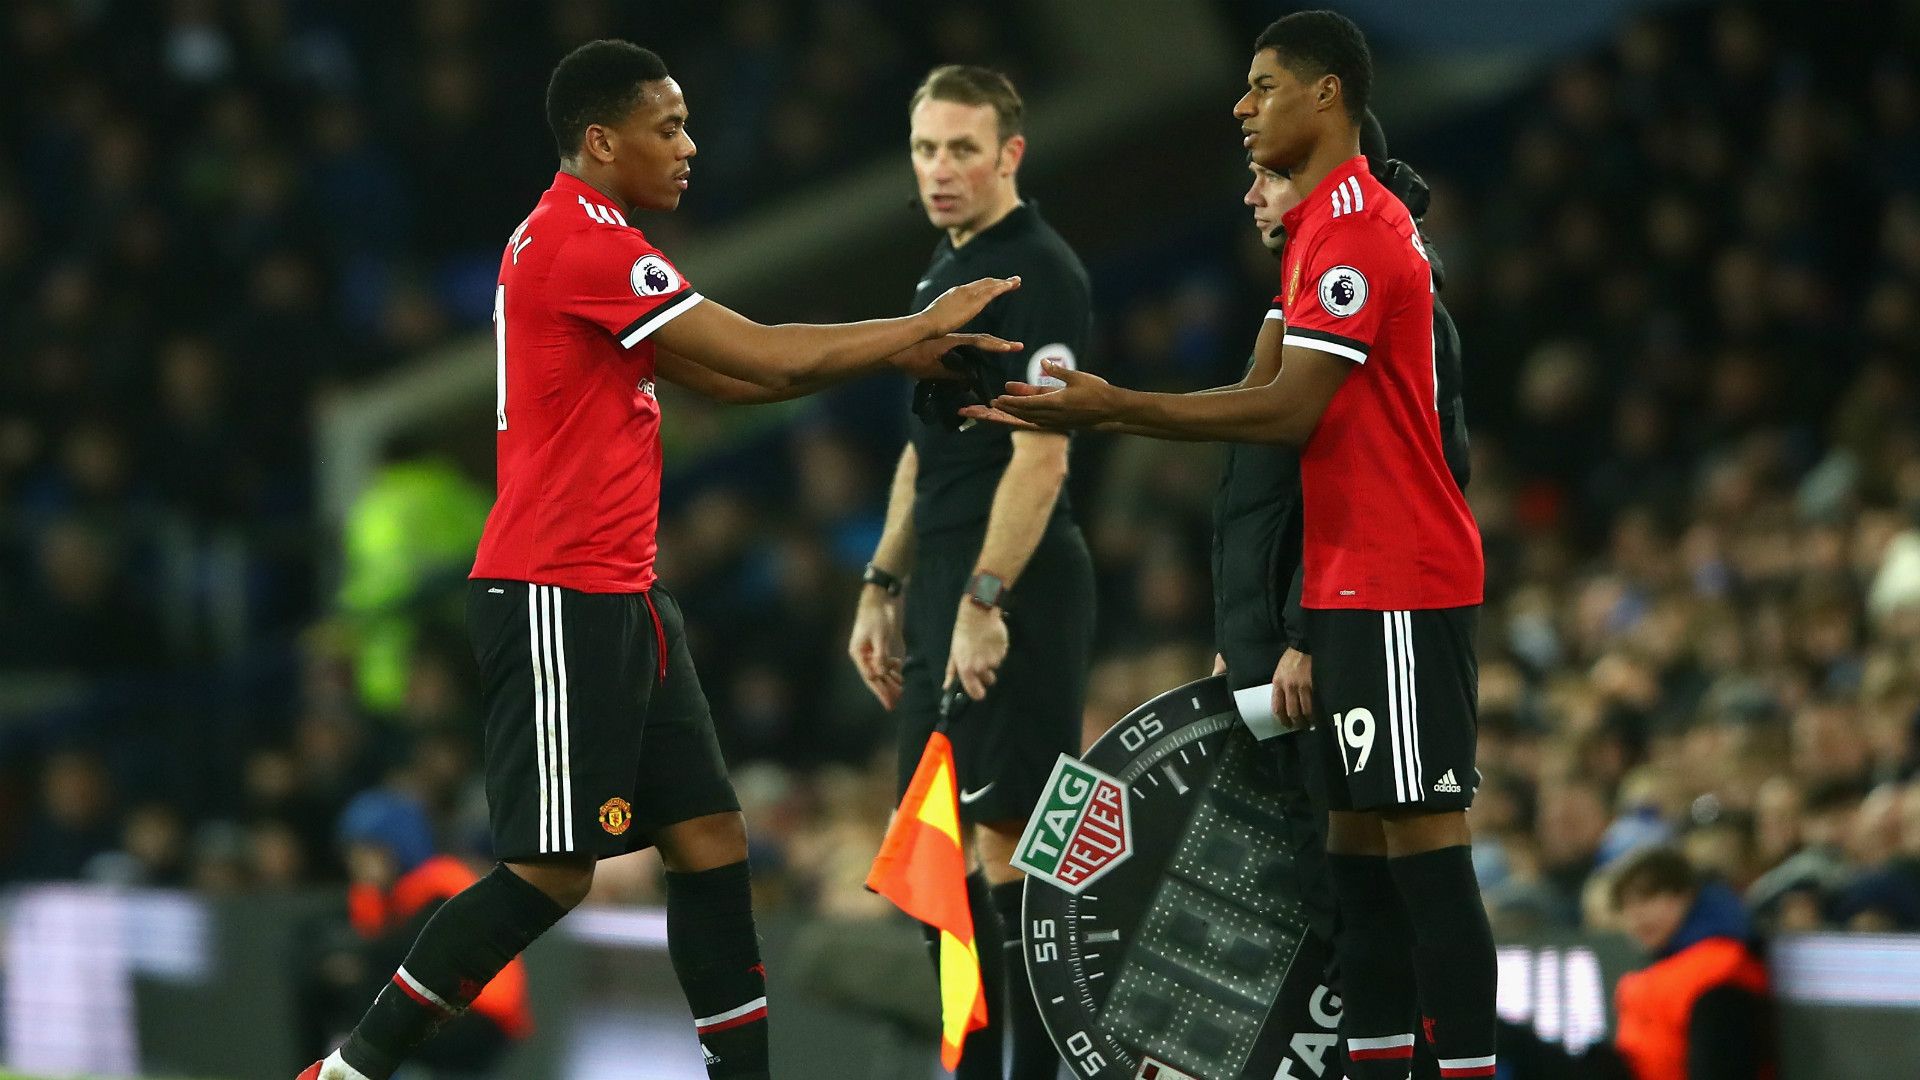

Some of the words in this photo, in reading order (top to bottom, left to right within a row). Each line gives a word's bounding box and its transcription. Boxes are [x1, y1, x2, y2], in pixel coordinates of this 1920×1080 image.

[1119, 712, 1164, 751] 05
[1333, 707, 1376, 776] 19
[1433, 783, 1461, 793] adidas
[1027, 773, 1090, 859] TAG
[1060, 785, 1122, 881] HEUER
[1033, 919, 1058, 962] 55
[1066, 1031, 1107, 1077] 50
